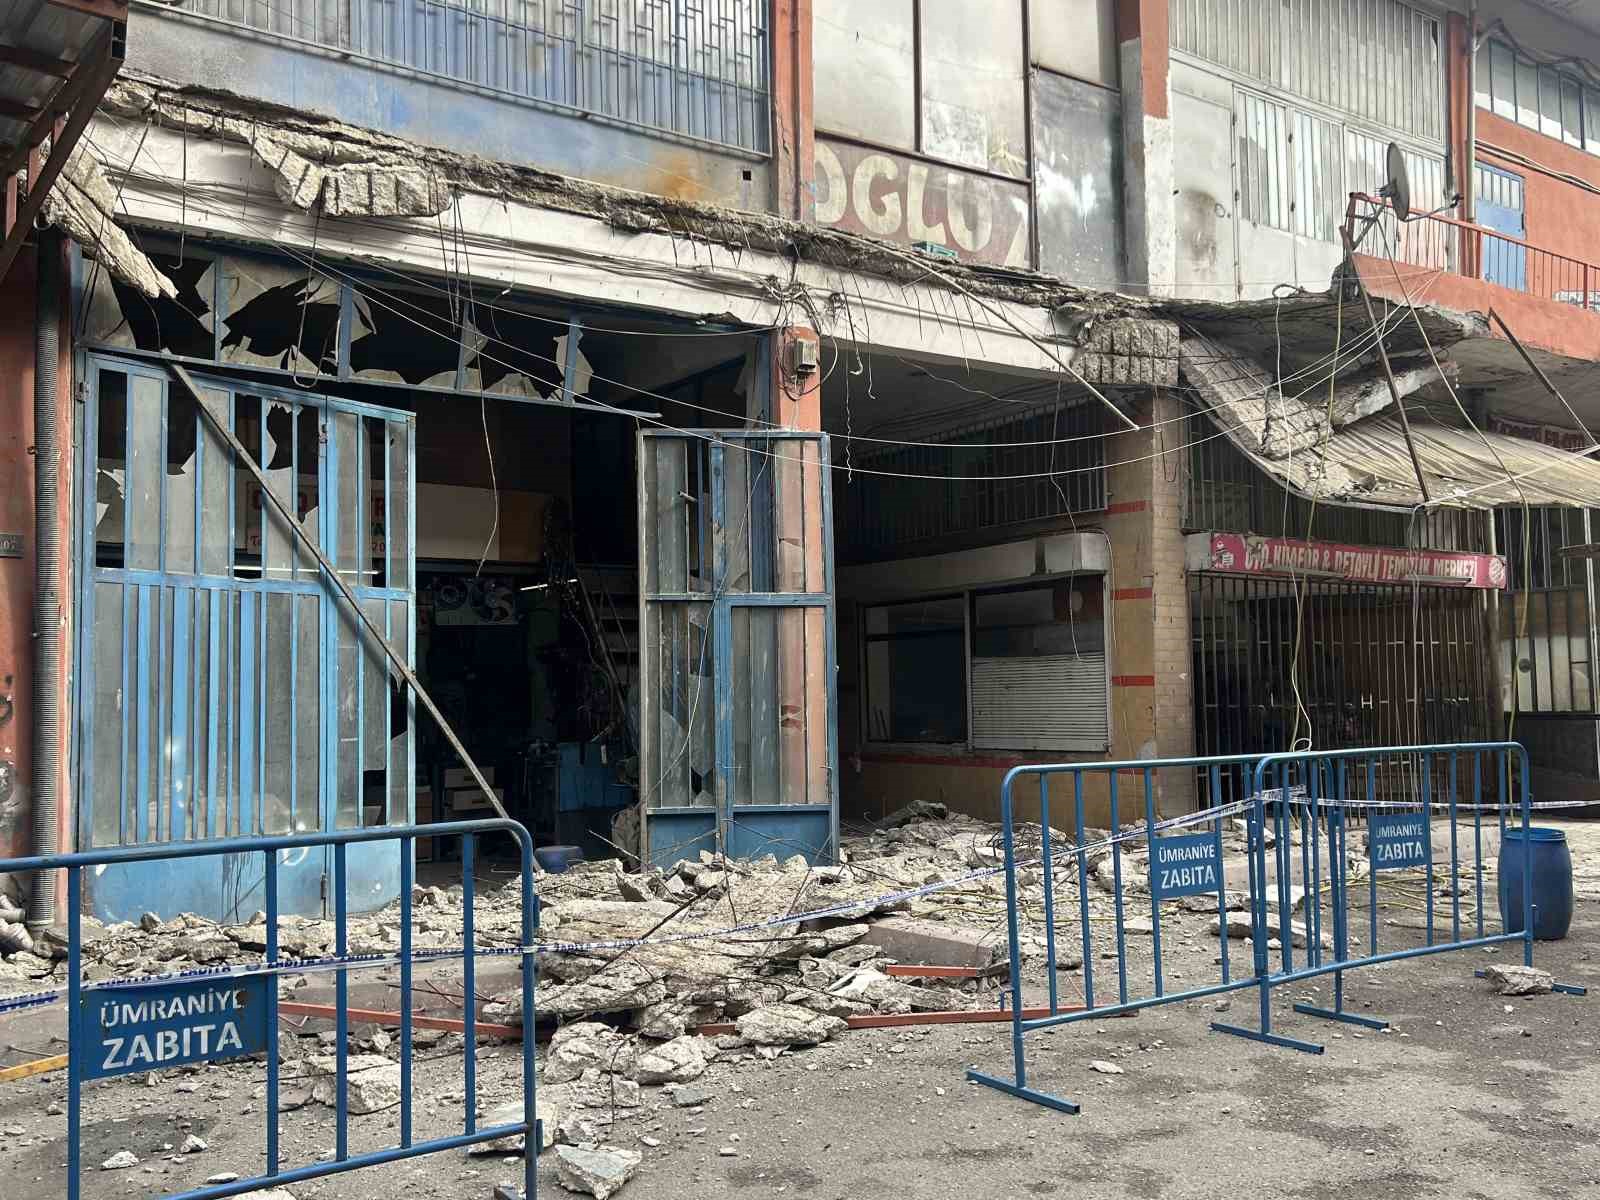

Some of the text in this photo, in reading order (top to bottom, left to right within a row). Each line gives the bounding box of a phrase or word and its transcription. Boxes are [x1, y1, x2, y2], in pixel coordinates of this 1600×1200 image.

[1159, 843, 1215, 863] ÜMRANİYE
[1376, 841, 1424, 861] ZABITA
[1161, 865, 1215, 888] ZABITA
[102, 1021, 243, 1070] ZABITA
